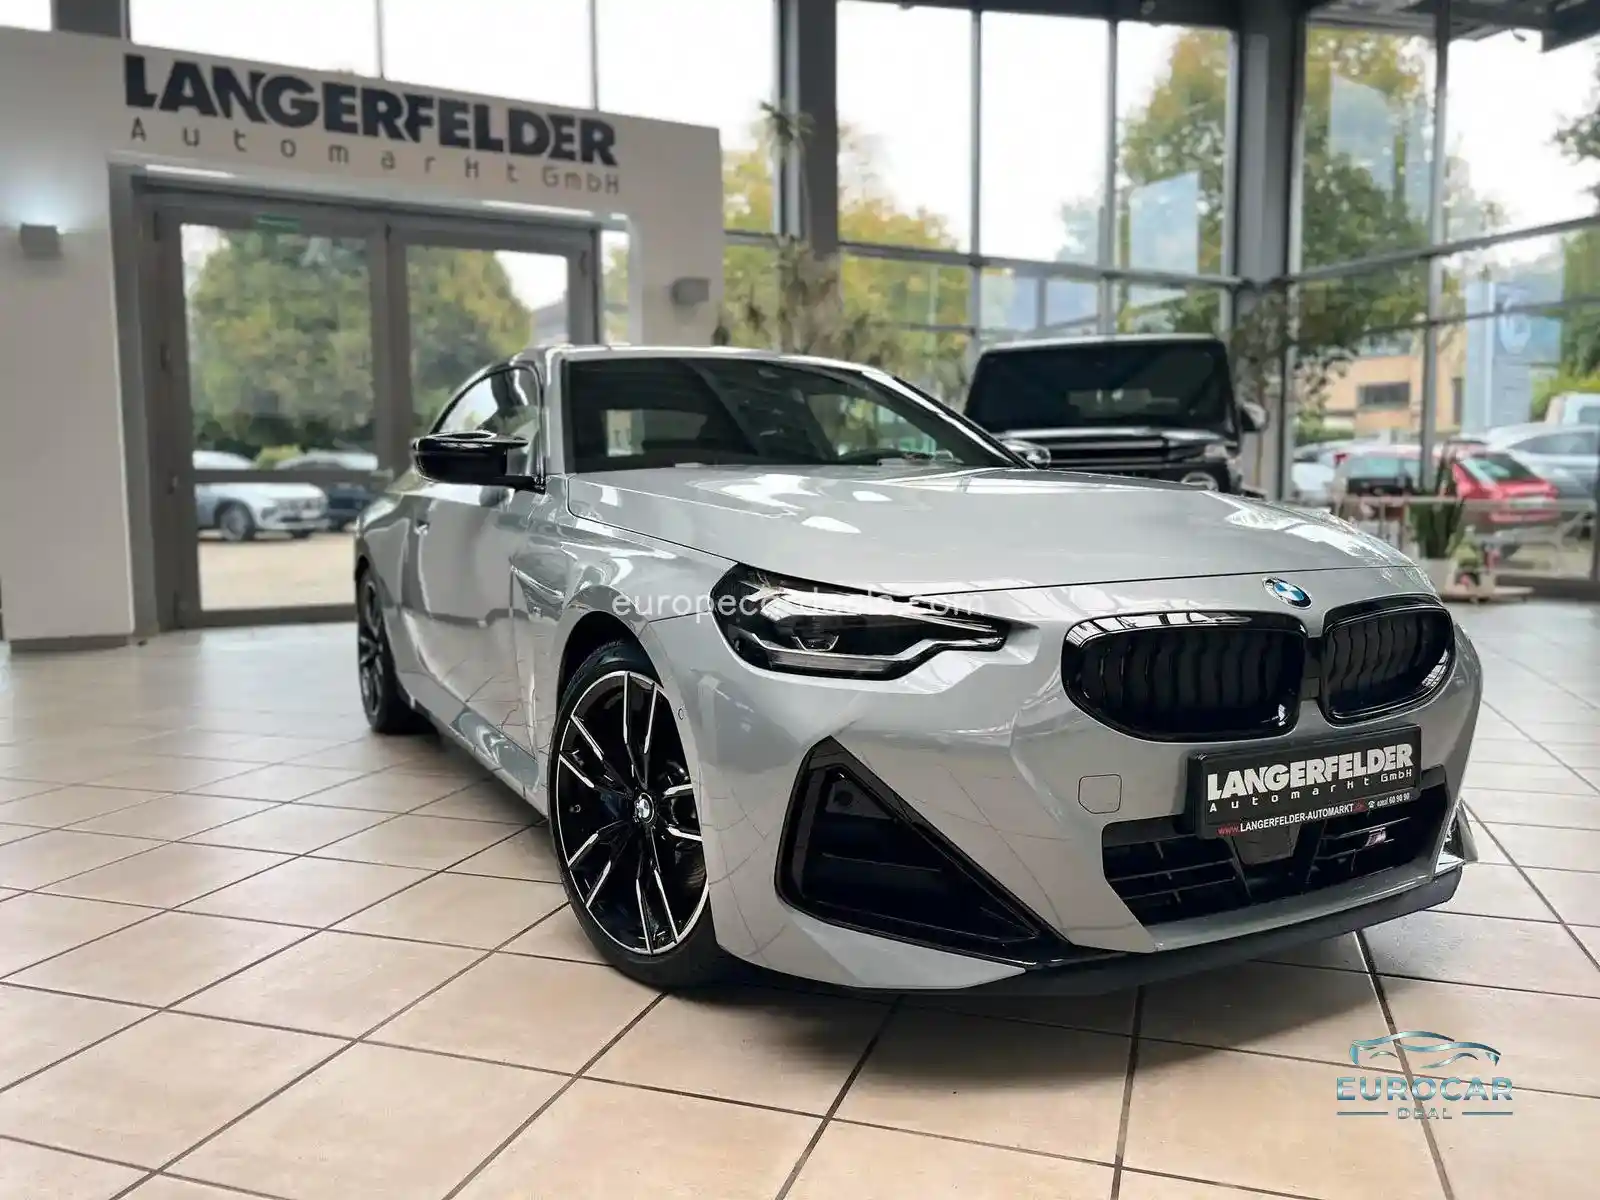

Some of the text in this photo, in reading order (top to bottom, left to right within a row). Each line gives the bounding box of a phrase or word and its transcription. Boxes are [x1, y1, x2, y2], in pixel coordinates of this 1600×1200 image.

[124, 54, 618, 166] LANGERFELDER
[542, 165, 619, 194] GmbH
[1207, 743, 1414, 800] LANGERFELDER
[1381, 768, 1412, 782] GmbH
